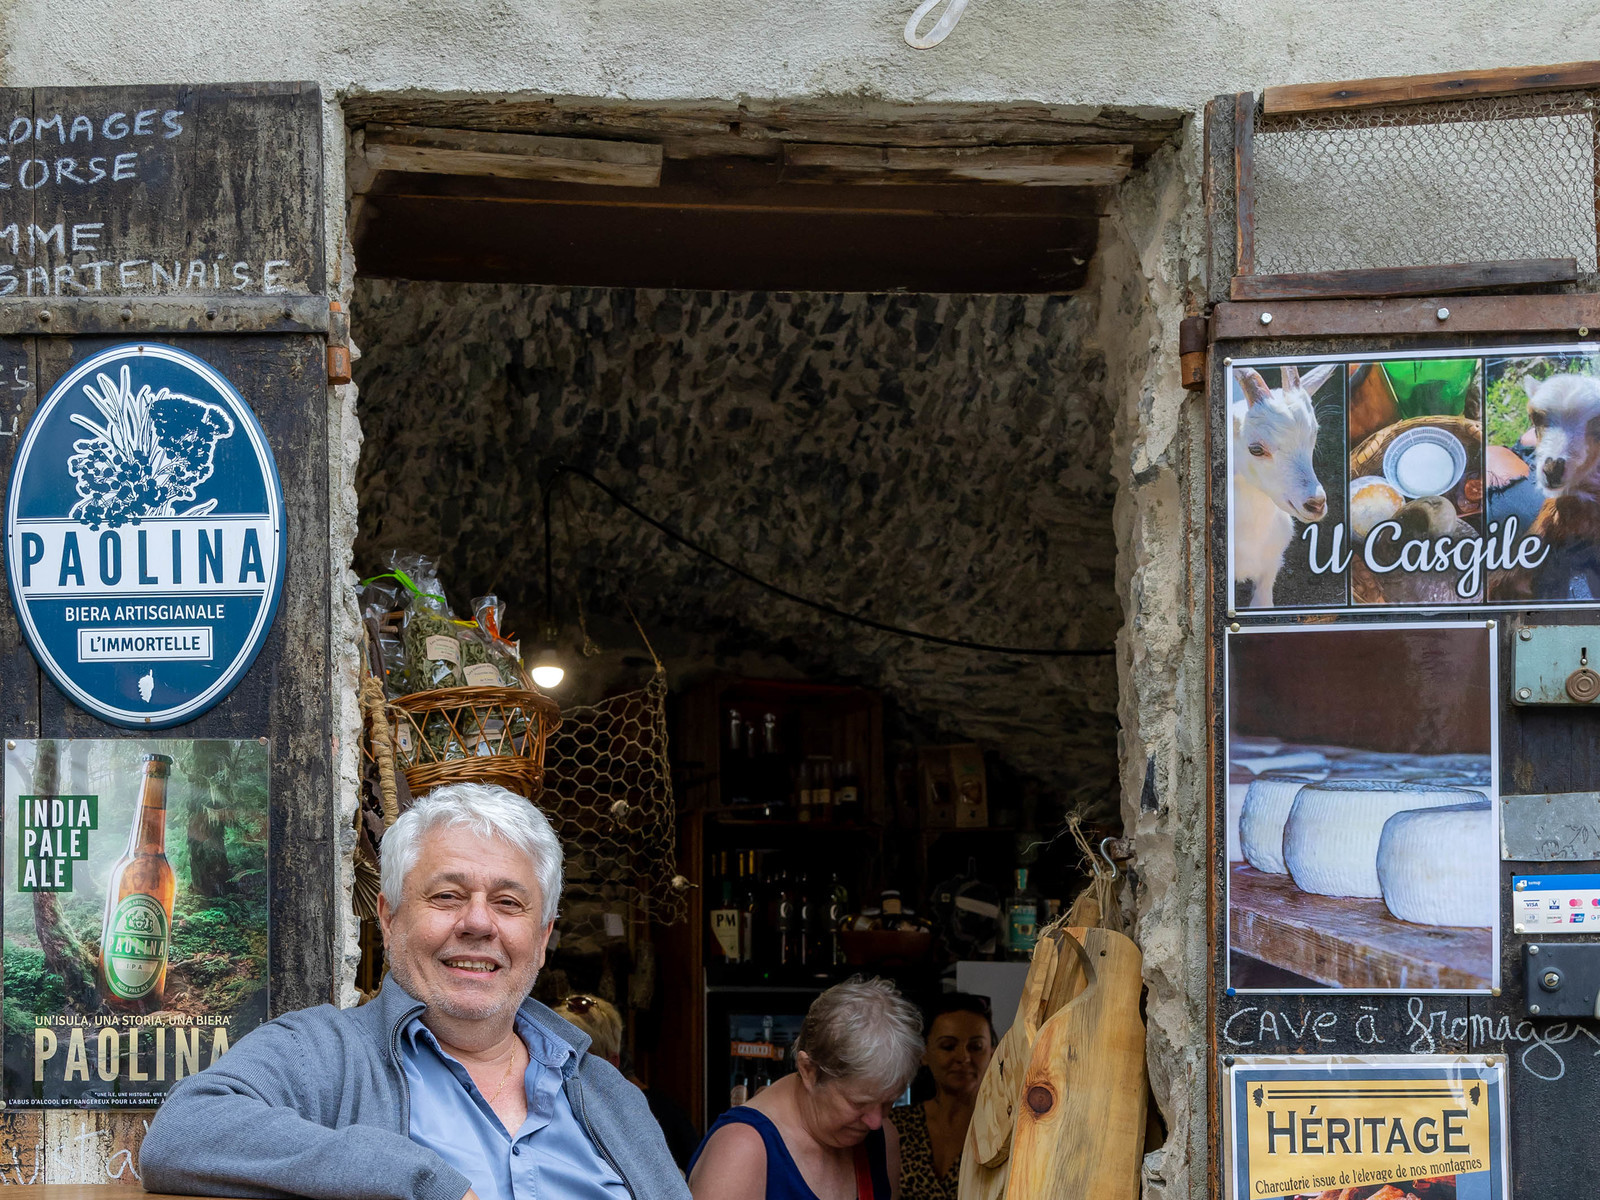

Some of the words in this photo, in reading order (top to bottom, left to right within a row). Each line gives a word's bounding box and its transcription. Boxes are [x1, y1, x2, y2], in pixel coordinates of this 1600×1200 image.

[0, 109, 185, 145] OMAGES
[21, 528, 266, 587] PAOLINA
[1302, 522, 1353, 575] U
[1363, 516, 1550, 597] Casgile
[65, 606, 111, 622] BIERA
[114, 604, 225, 621] ARTISGIANALE
[90, 635, 201, 652] L'IMMORTELLE
[24, 800, 91, 828] INDIA
[24, 830, 81, 858] PALE
[23, 859, 65, 888] ALE
[716, 913, 736, 928] PM
[108, 936, 165, 957] PAOLINA
[35, 1015, 92, 1028] UN'ISULA,
[94, 1015, 119, 1026] UNA
[122, 1015, 166, 1028] STORIA,
[169, 1015, 194, 1026] UNA
[1267, 1105, 1471, 1156] HÉRITAGE
[1255, 1175, 1310, 1195] Charcuterie
[1312, 1173, 1337, 1188] issue
[1339, 1171, 1351, 1186] de
[1353, 1166, 1394, 1184] l'élevage
[1396, 1164, 1408, 1179] de
[1410, 1165, 1428, 1177] nos
[1430, 1158, 1483, 1176] montagnes
